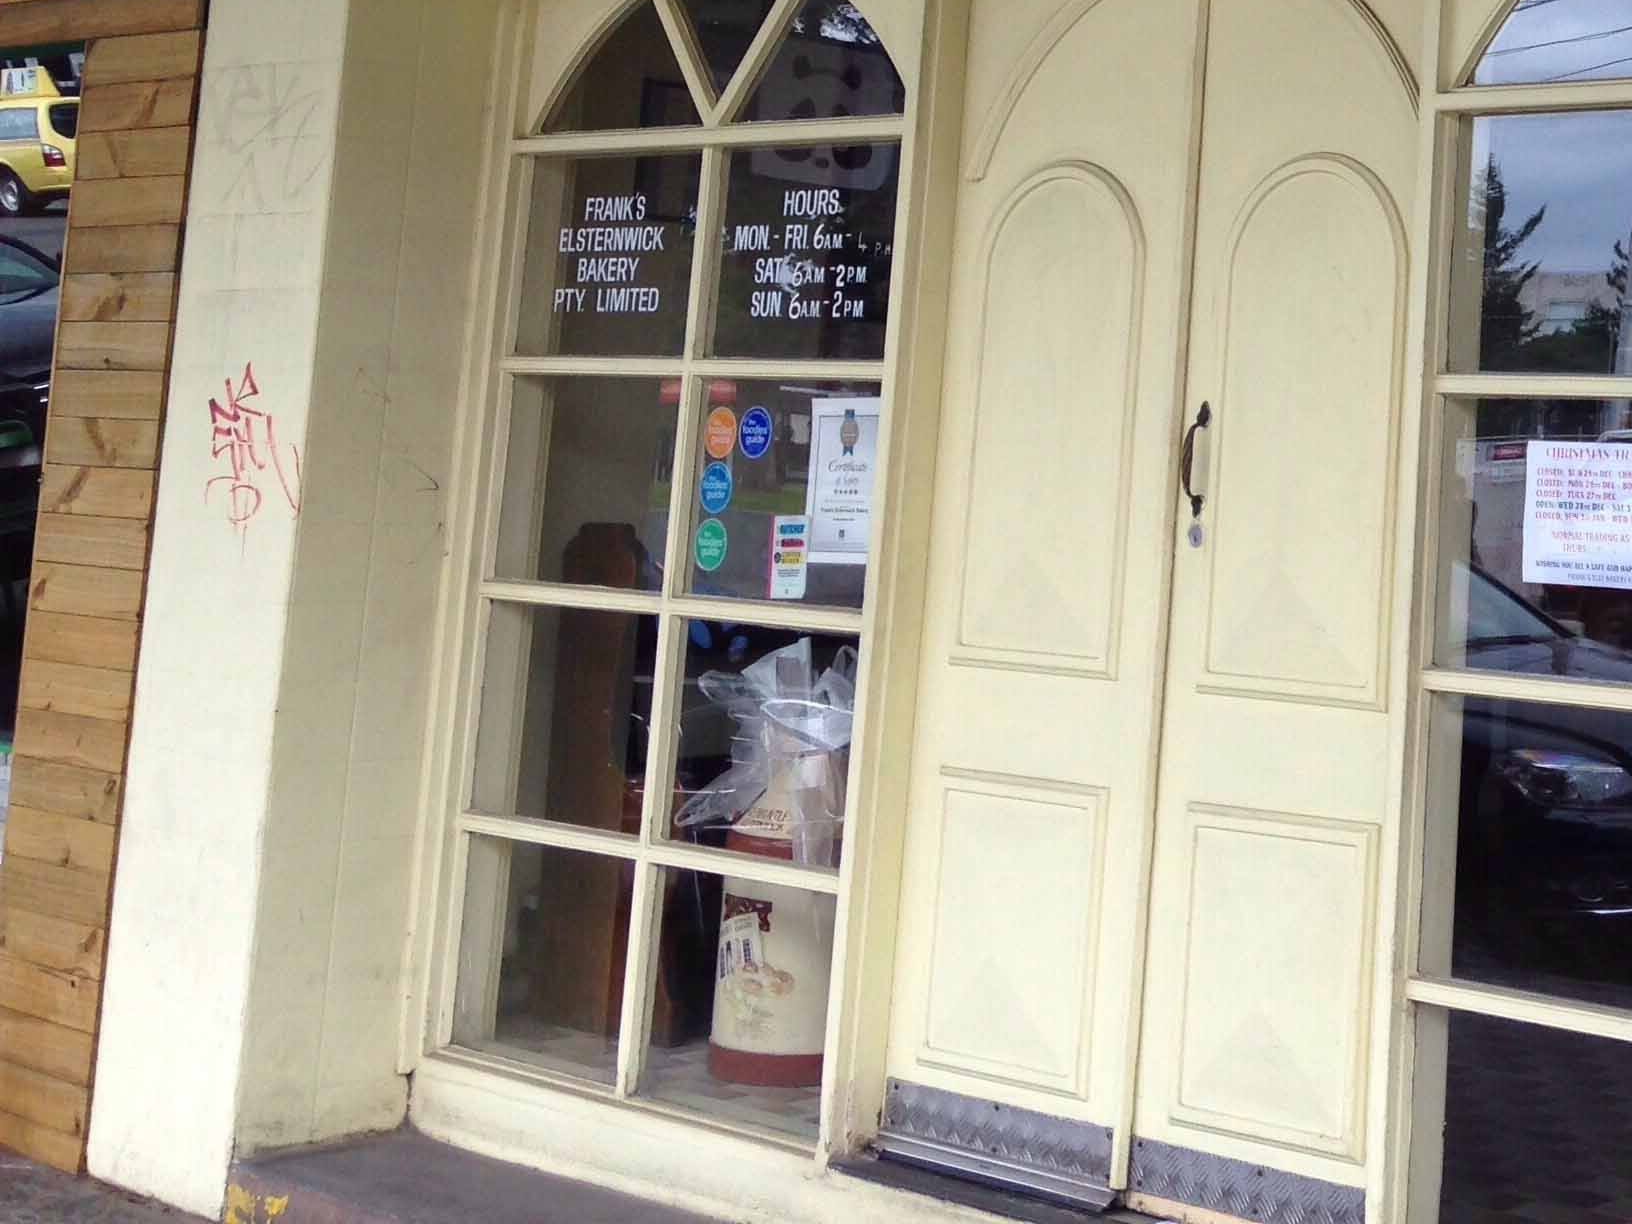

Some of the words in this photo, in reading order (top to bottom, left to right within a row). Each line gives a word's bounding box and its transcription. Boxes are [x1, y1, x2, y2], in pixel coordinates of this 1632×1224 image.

[585, 192, 646, 221] FRANK'S
[783, 189, 840, 216] HOURS
[559, 227, 664, 252] ELSTERNWICK
[577, 257, 640, 282] BAKERY
[554, 288, 586, 313] PTY.
[597, 287, 660, 313] LIMITED
